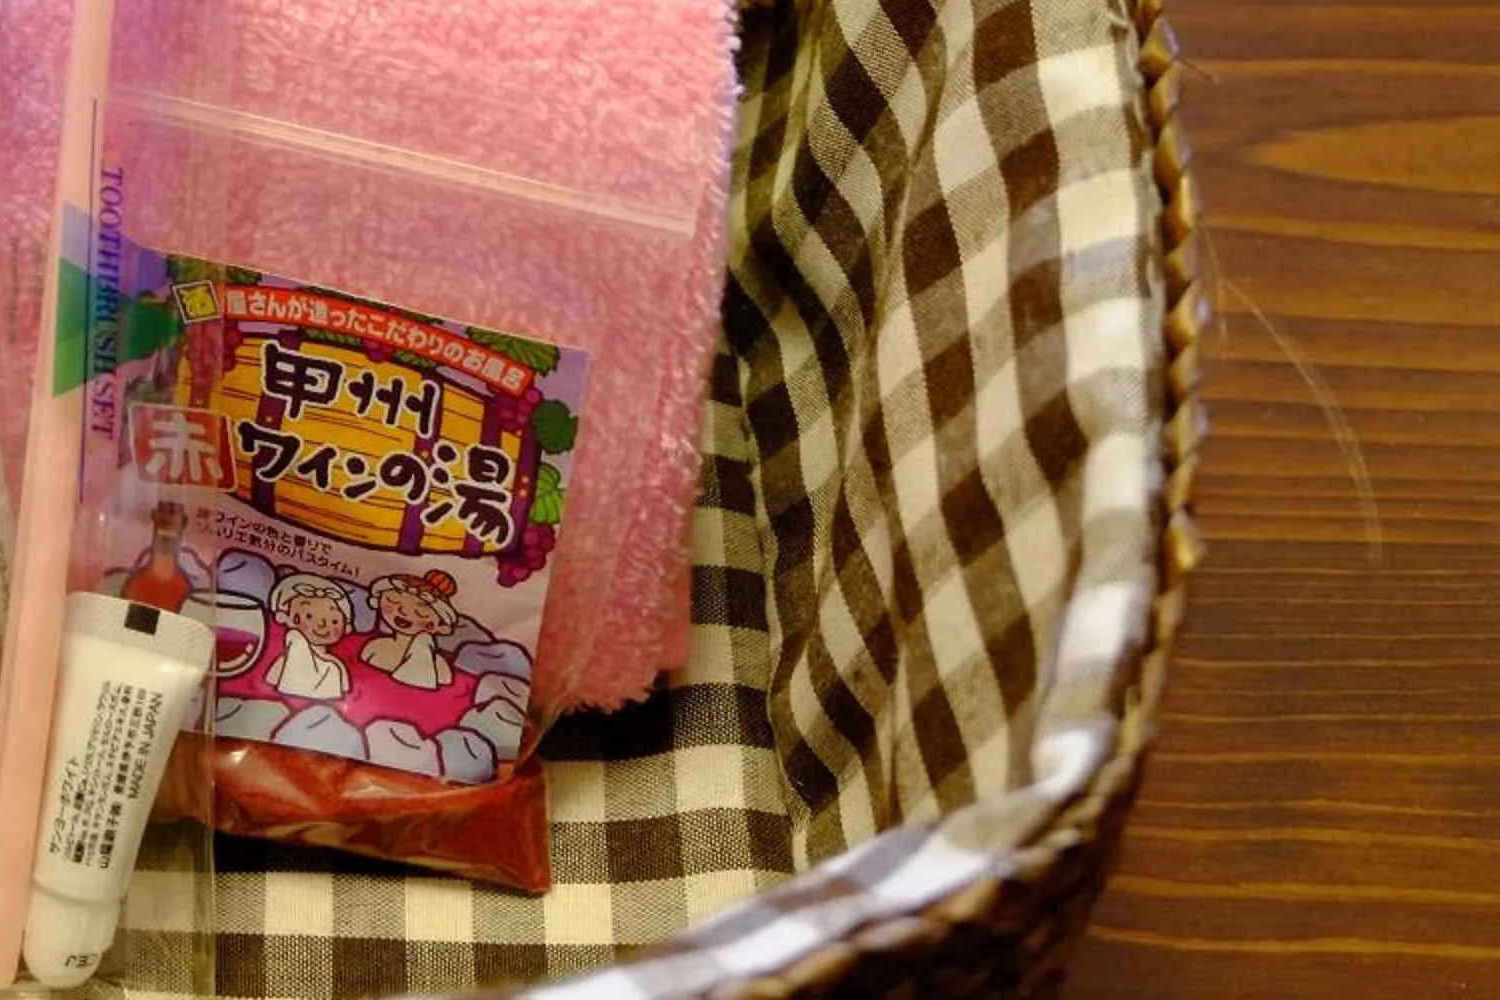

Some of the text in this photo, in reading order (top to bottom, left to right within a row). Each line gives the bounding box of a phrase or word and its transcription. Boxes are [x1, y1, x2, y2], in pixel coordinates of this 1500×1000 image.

[91, 167, 123, 440] TOOTHBRUSH SET
[262, 343, 440, 437] 甲州
[145, 419, 223, 481] 赤
[237, 421, 513, 545] ワインの湯
[127, 758, 148, 799] MADE
[143, 691, 164, 740] JAPAN
